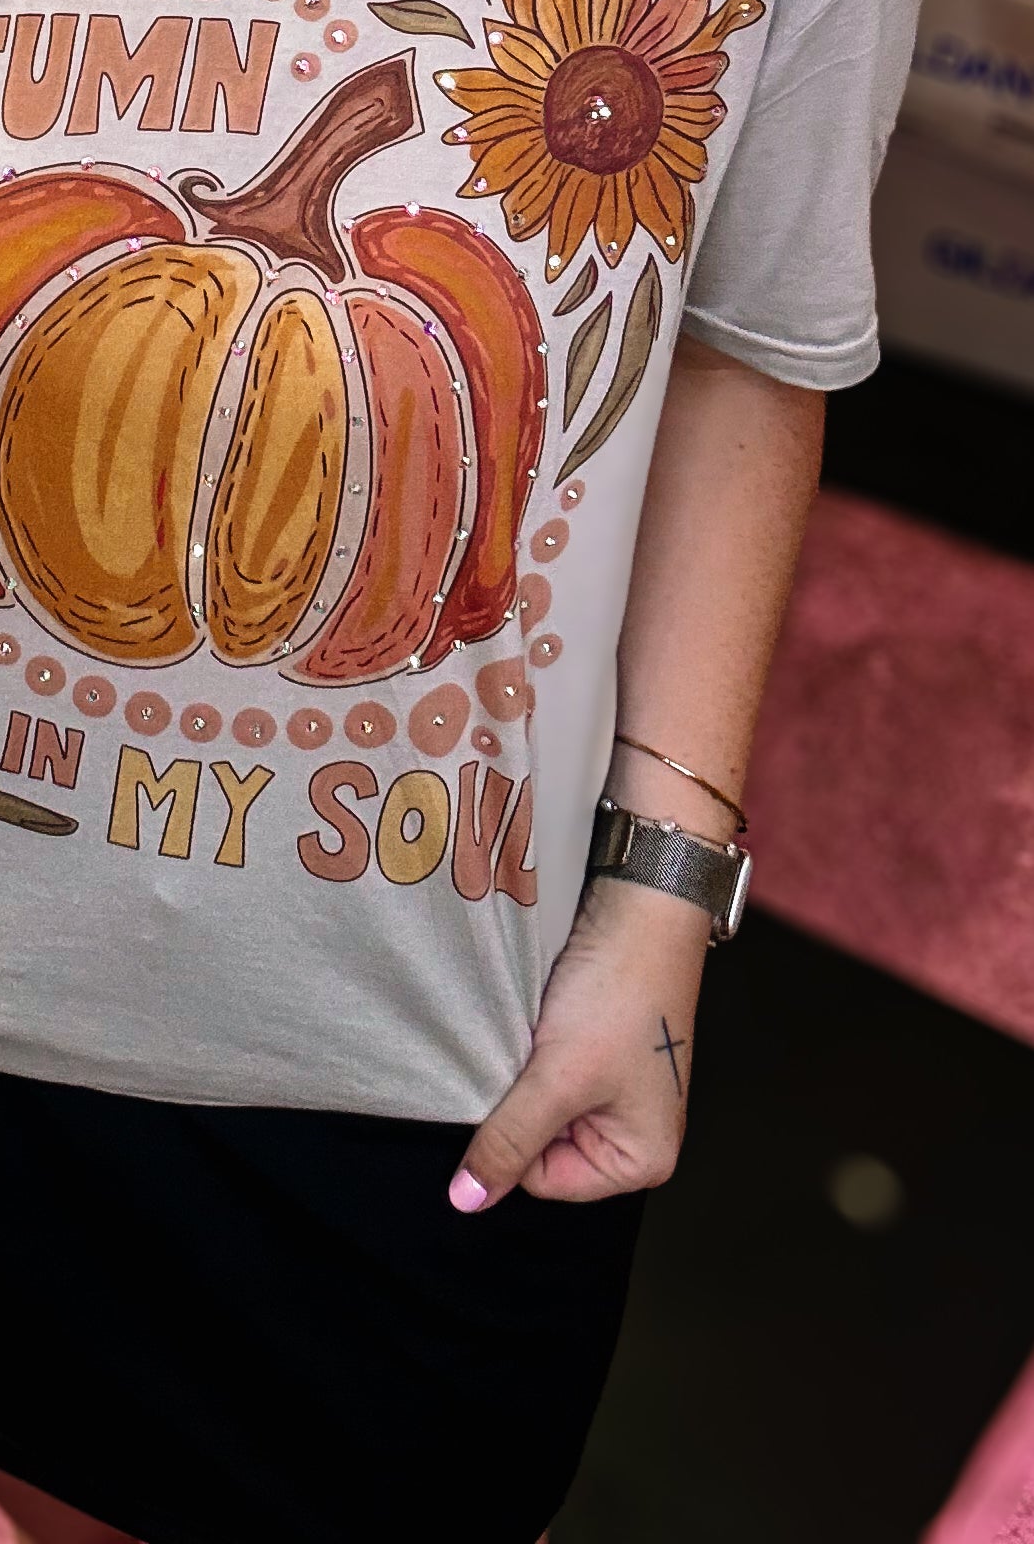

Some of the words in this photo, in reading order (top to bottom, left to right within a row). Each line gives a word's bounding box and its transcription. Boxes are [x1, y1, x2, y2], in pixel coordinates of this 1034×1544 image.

[0, 710, 85, 789] IN
[107, 744, 275, 868] MY
[297, 760, 538, 907] SOUL
